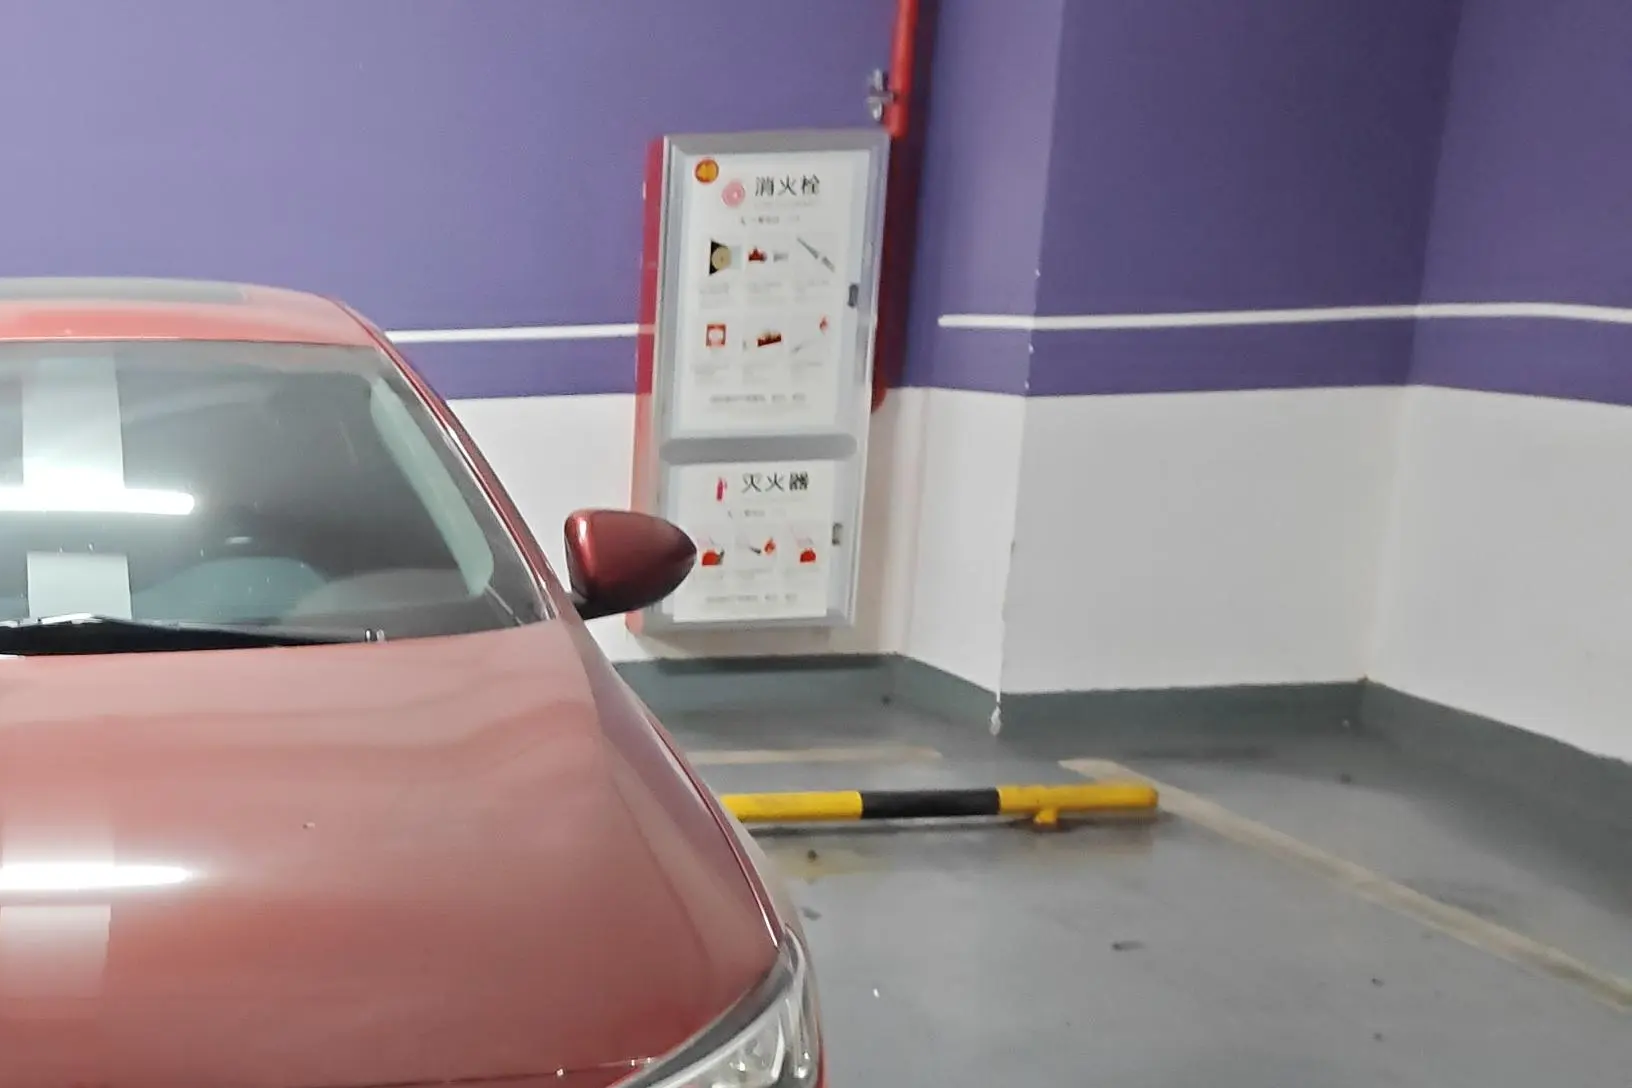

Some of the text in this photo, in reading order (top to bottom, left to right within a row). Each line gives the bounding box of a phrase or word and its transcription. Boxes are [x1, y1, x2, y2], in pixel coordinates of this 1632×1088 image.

[755, 174, 820, 196] 消火栓
[741, 471, 809, 493] 灭火器
